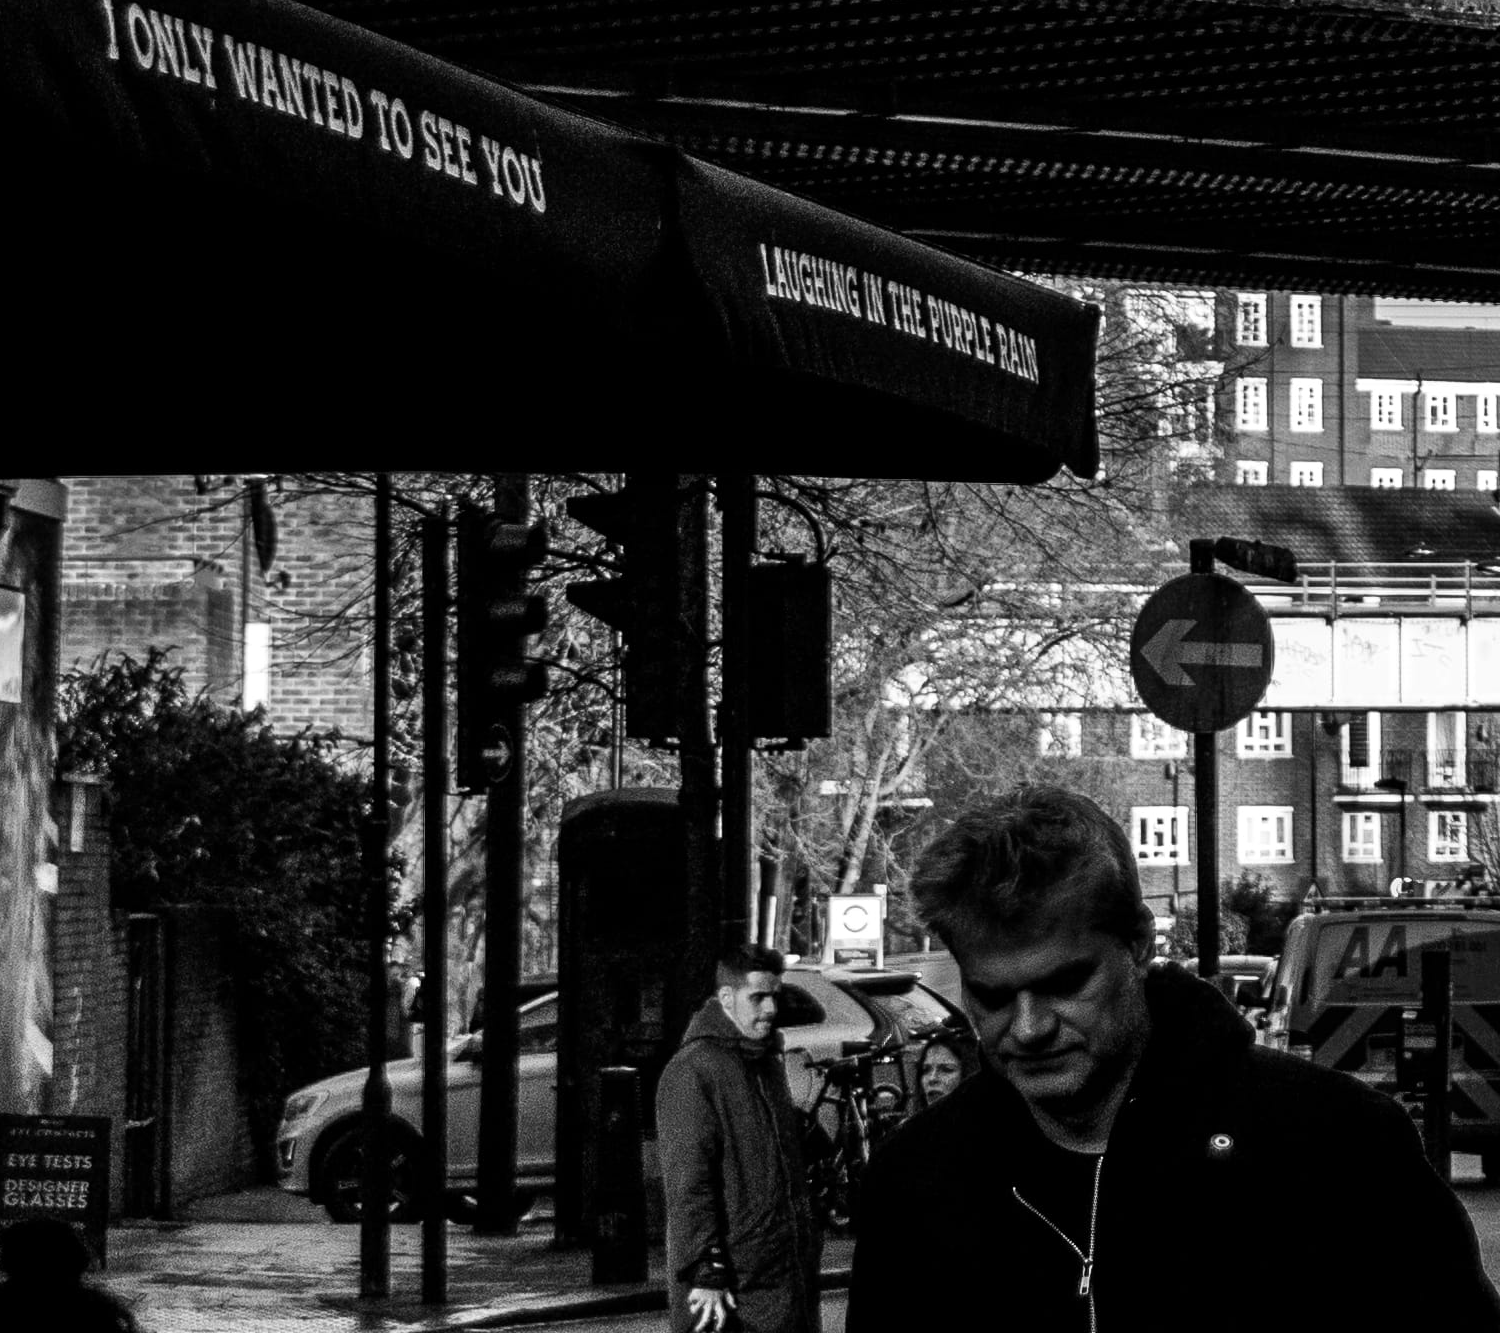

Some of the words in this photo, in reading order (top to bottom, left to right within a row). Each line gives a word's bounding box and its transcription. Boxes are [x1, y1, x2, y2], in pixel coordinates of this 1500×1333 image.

[127, 2, 218, 90] ONLY
[222, 33, 365, 140] WANTED
[369, 88, 414, 160] TO
[420, 109, 478, 186] SEE
[480, 134, 547, 214] YOU
[758, 242, 862, 319] LAUGHING
[863, 270, 888, 326] IN
[886, 279, 928, 339] THE
[926, 293, 996, 366] PURPLE
[995, 321, 1040, 385] RAIN
[1334, 925, 1408, 978] AA
[6, 1152, 38, 1168] EYE
[43, 1153, 93, 1170] TESTS
[3, 1192, 88, 1209] GLASSES
[4, 1179, 90, 1193] DESIGNER
